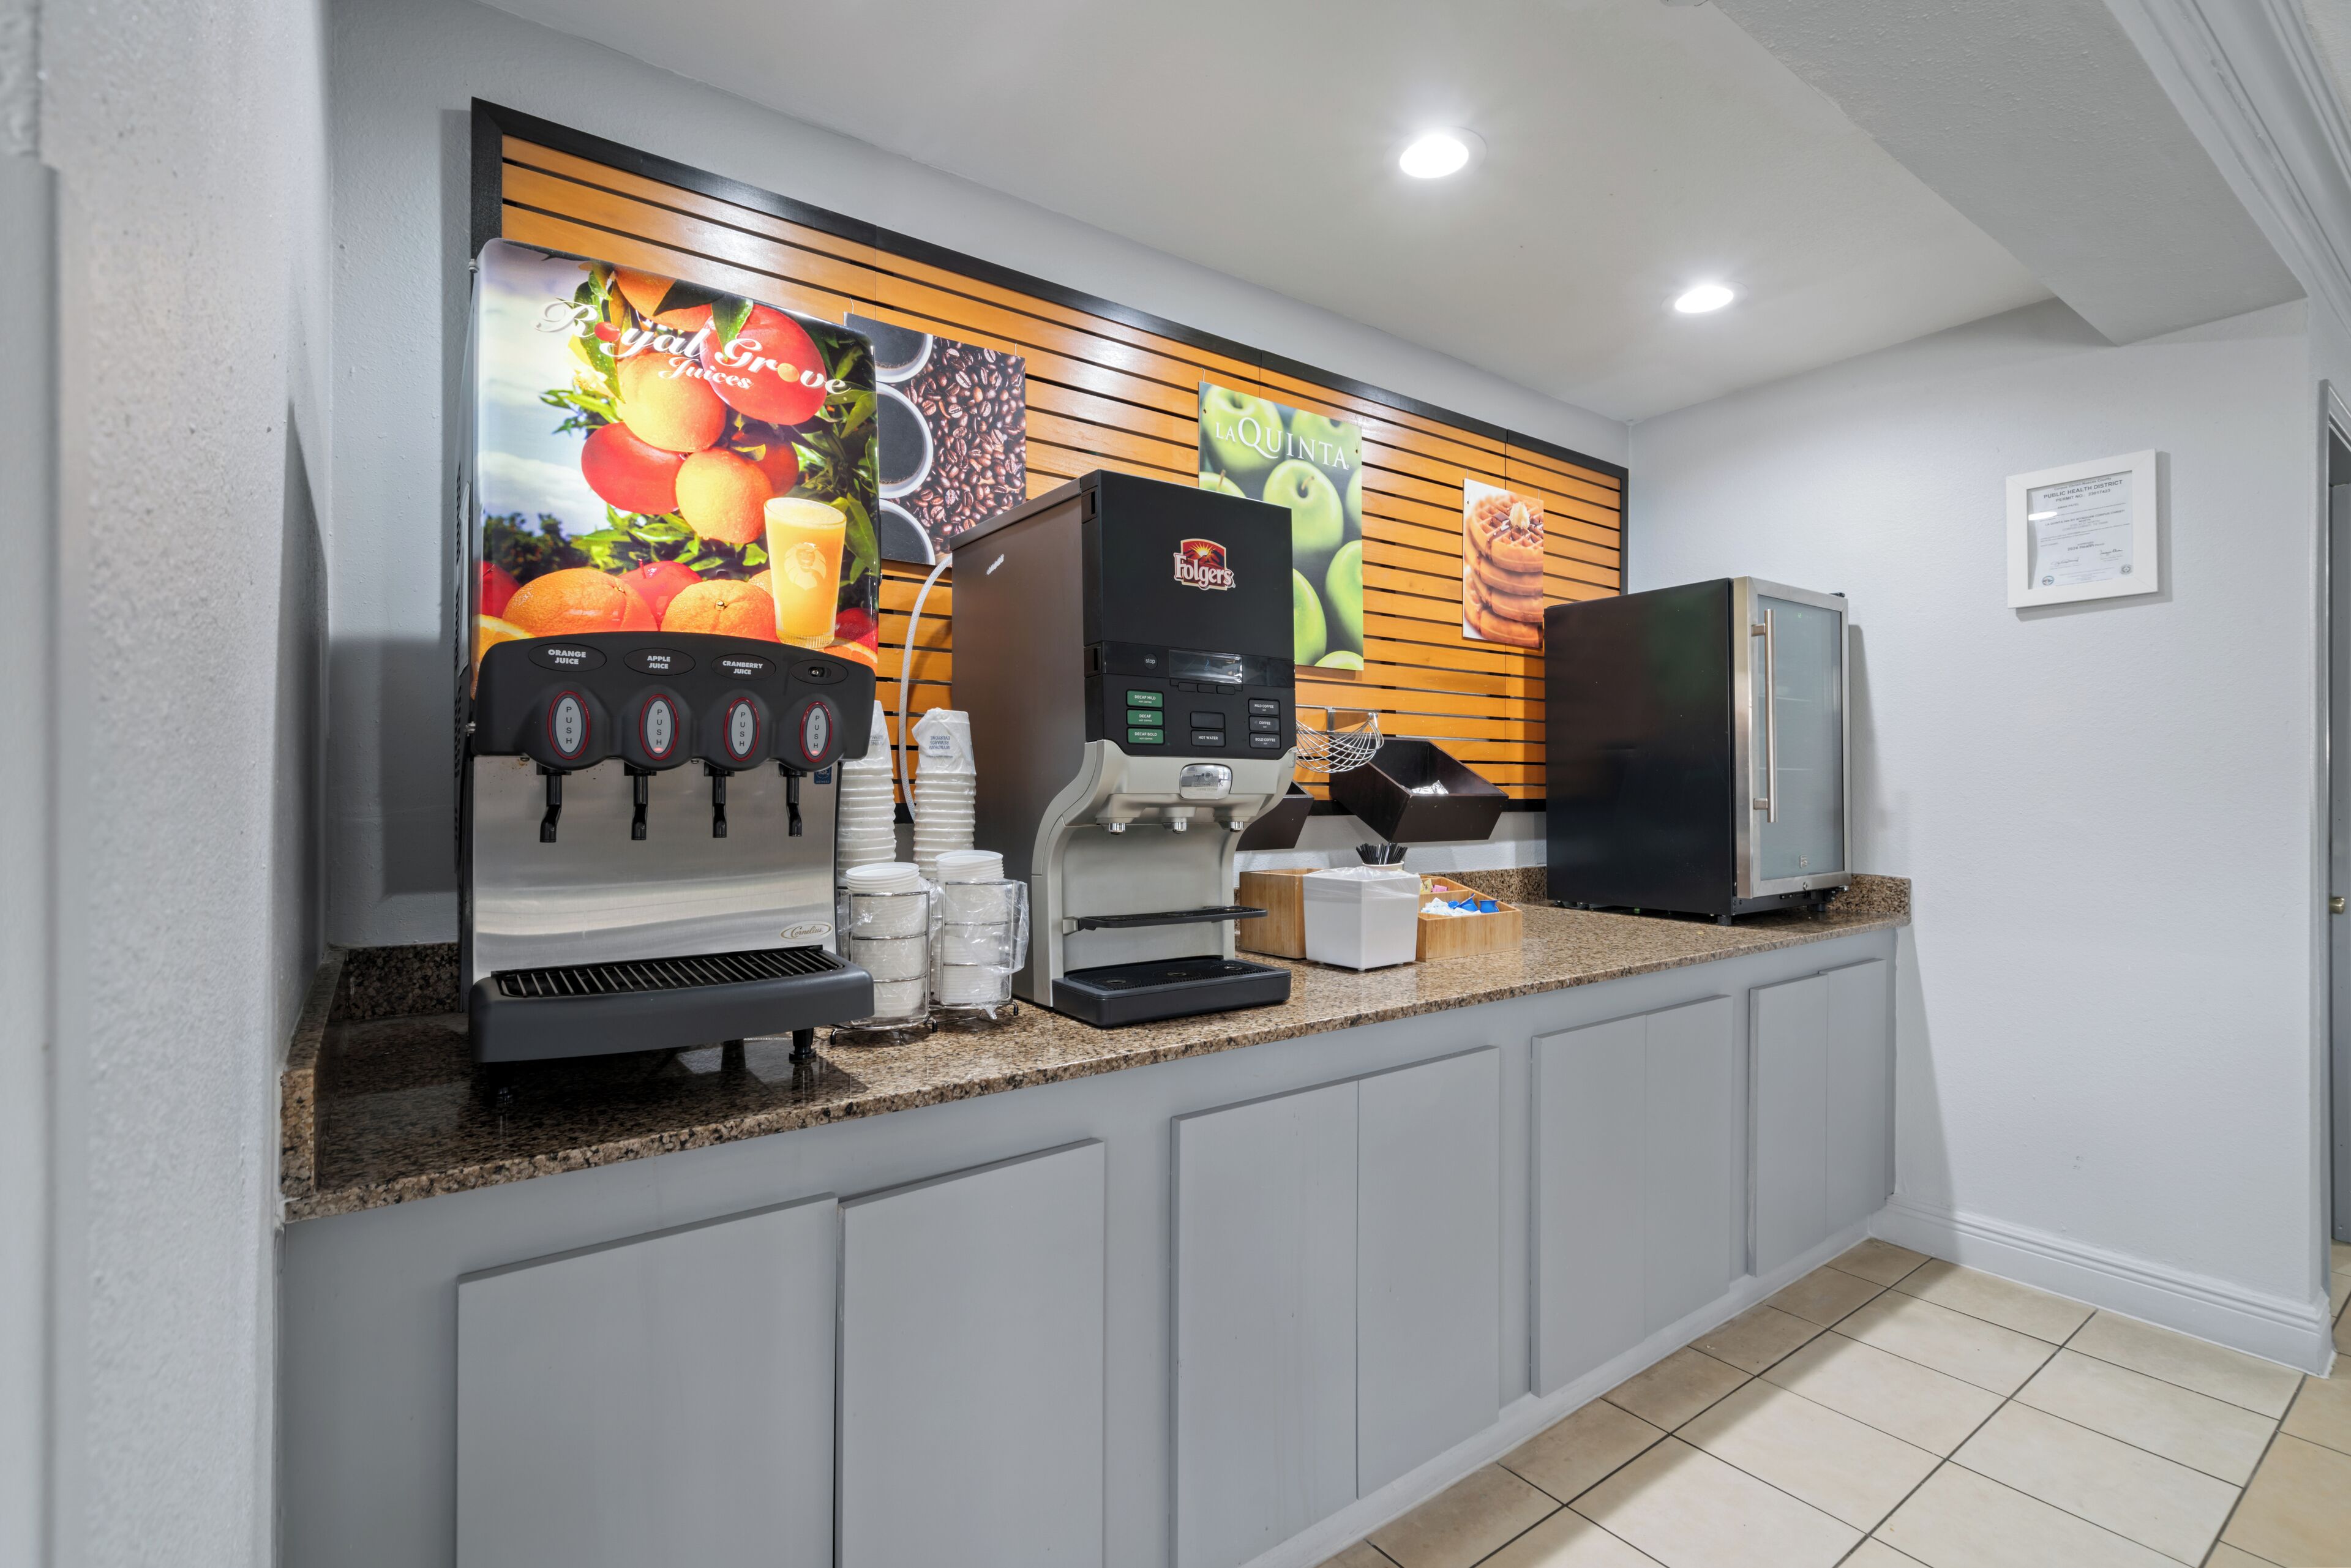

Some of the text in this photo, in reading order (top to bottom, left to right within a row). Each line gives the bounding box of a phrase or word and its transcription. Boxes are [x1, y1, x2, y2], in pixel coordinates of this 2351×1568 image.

[534, 301, 852, 395] Royal Grove
[658, 357, 754, 390] Juices
[1215, 417, 1349, 470] LA QUINTA
[2044, 479, 2123, 499] PUBLIC HEALTH DISTRICT
[1174, 553, 1233, 588] Folgers
[548, 649, 586, 658] ORANGE
[722, 660, 763, 669] CRANBERRY
[790, 925, 823, 938] Cornelius
